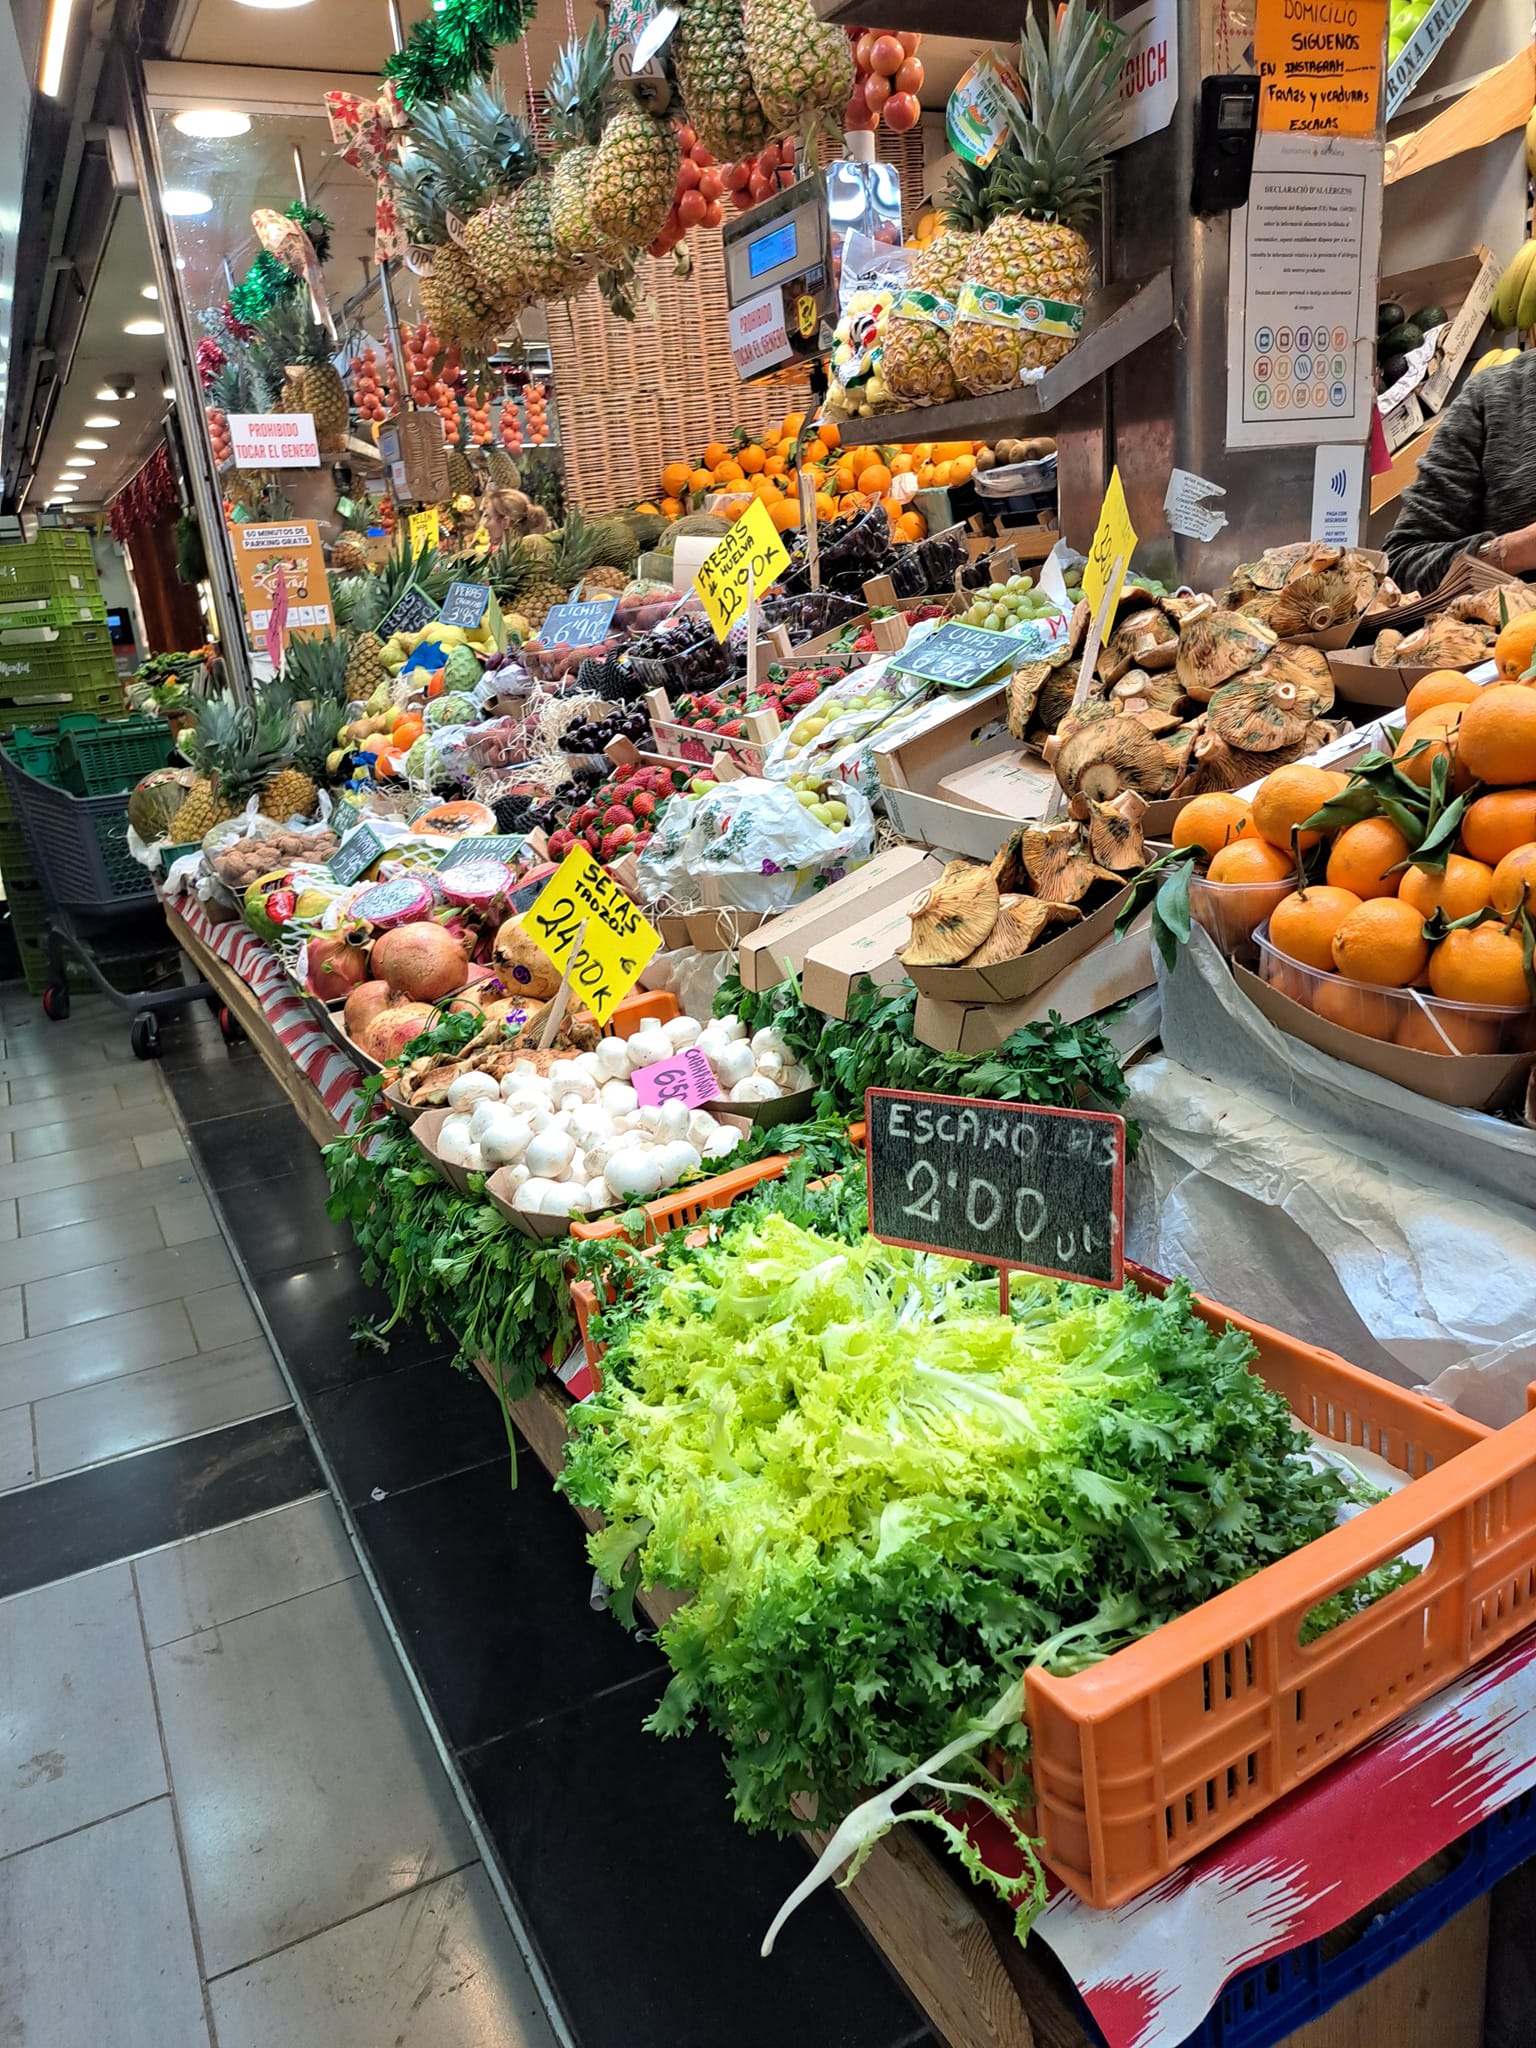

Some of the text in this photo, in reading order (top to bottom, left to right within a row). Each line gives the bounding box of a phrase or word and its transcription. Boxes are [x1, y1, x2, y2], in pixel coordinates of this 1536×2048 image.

[1284, 0, 1358, 27] DOMICILIO
[1291, 32, 1361, 51] SIGUENOS
[1119, 40, 1168, 98] OUCH
[1260, 59, 1344, 77] EN INSTAGRAM
[1385, 42, 1424, 104] RONA
[248, 422, 299, 437] PROHIBIDO
[236, 443, 317, 459] TOCAR EL GENERO
[245, 537, 310, 548] PARKING GRATIS
[258, 528, 294, 537] MINUTOS
[295, 527, 305, 535] DE
[697, 520, 748, 589] FRESAS
[720, 535, 755, 577] HUELVA
[558, 604, 602, 617] LICHIS
[949, 626, 1004, 649] UVAS
[583, 863, 642, 934] SETAS
[901, 1159, 1049, 1244] 2'00
